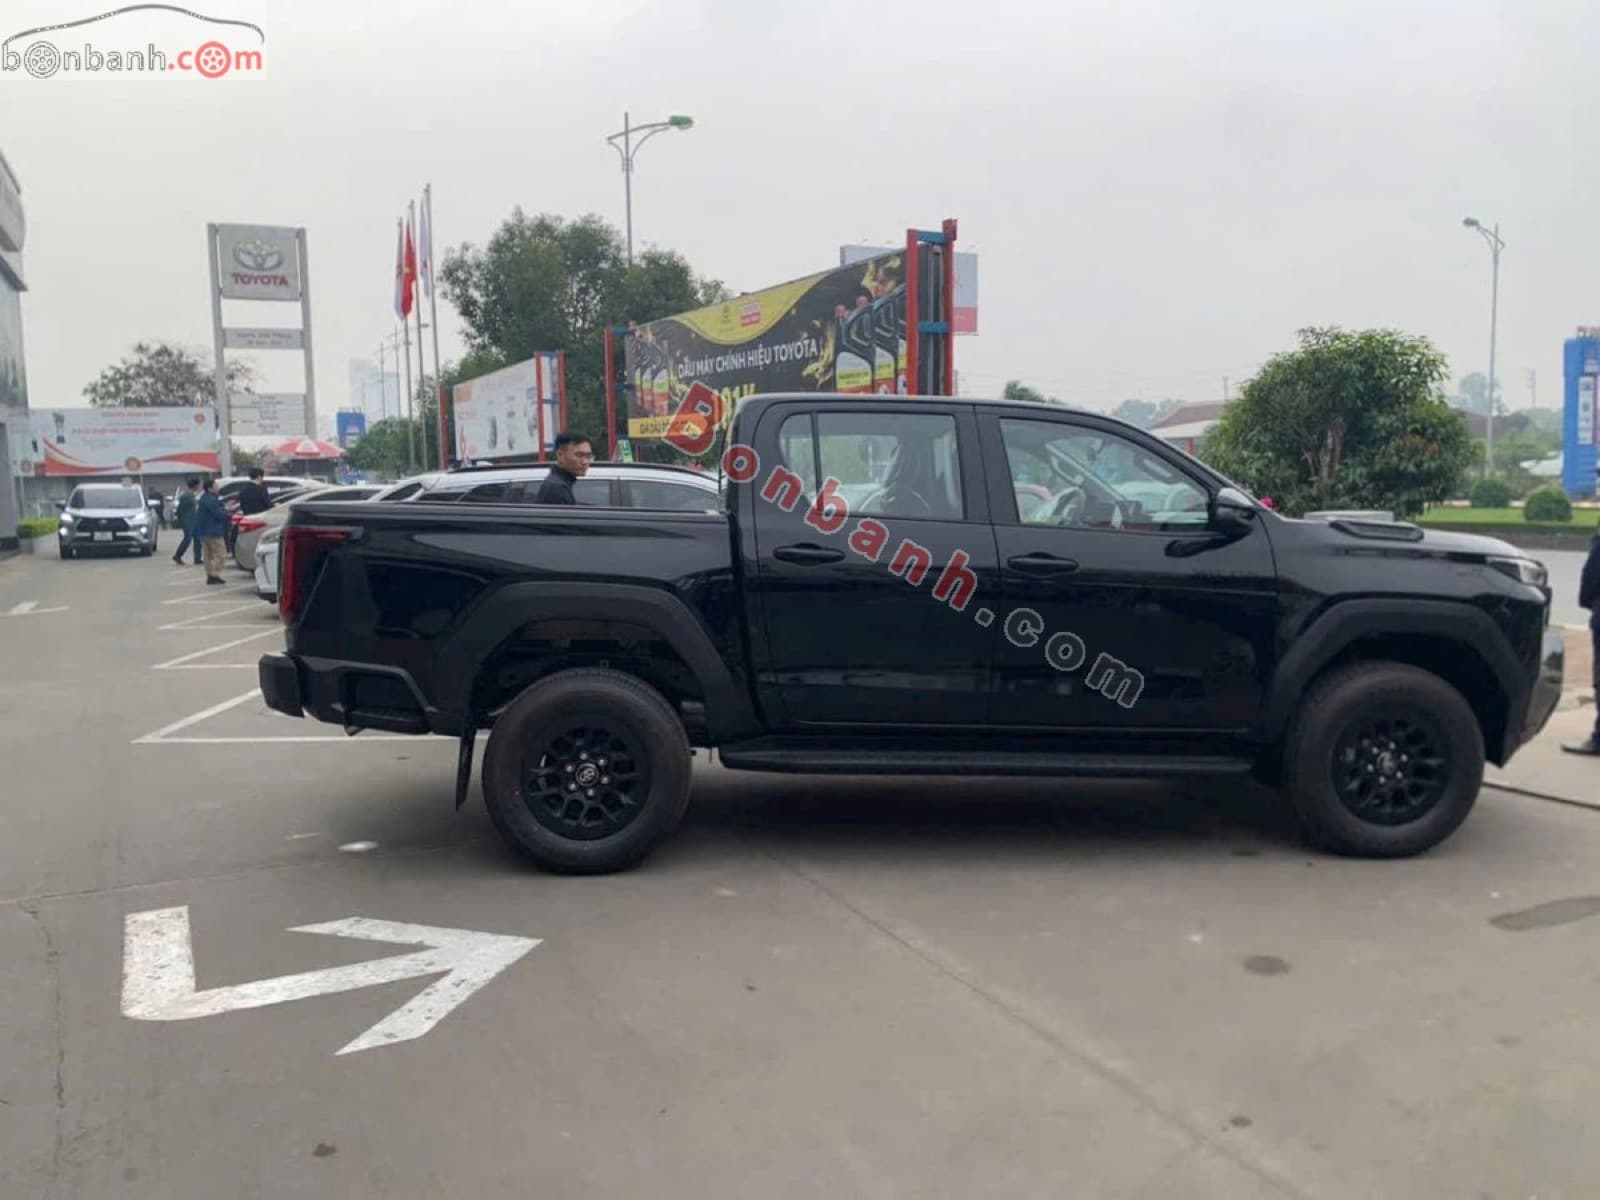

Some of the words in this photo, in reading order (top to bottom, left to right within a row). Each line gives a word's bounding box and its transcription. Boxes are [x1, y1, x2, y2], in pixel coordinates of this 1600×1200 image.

[232, 273, 288, 287] TOYOTA
[696, 353, 715, 376] MÁY
[715, 350, 746, 373] CHÍNH
[747, 344, 772, 370] HIỆU
[774, 338, 818, 363] TOYOTA
